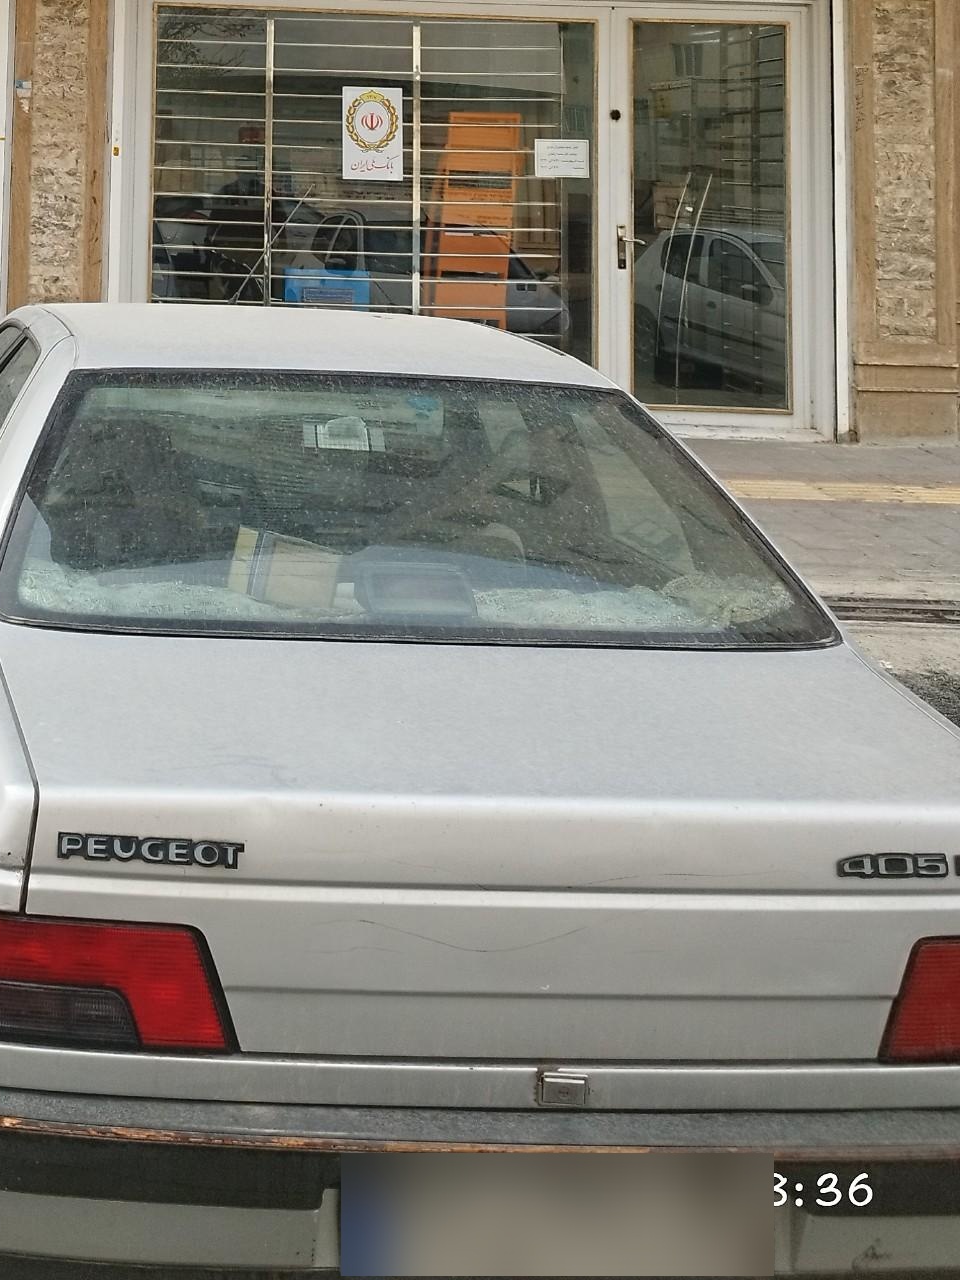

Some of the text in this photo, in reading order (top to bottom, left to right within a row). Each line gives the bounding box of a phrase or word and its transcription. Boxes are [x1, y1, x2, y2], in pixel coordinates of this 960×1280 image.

[351, 159, 368, 172] ایران
[374, 155, 400, 174] بانک
[59, 833, 242, 867] PEUGEOT
[839, 854, 948, 877] 405
